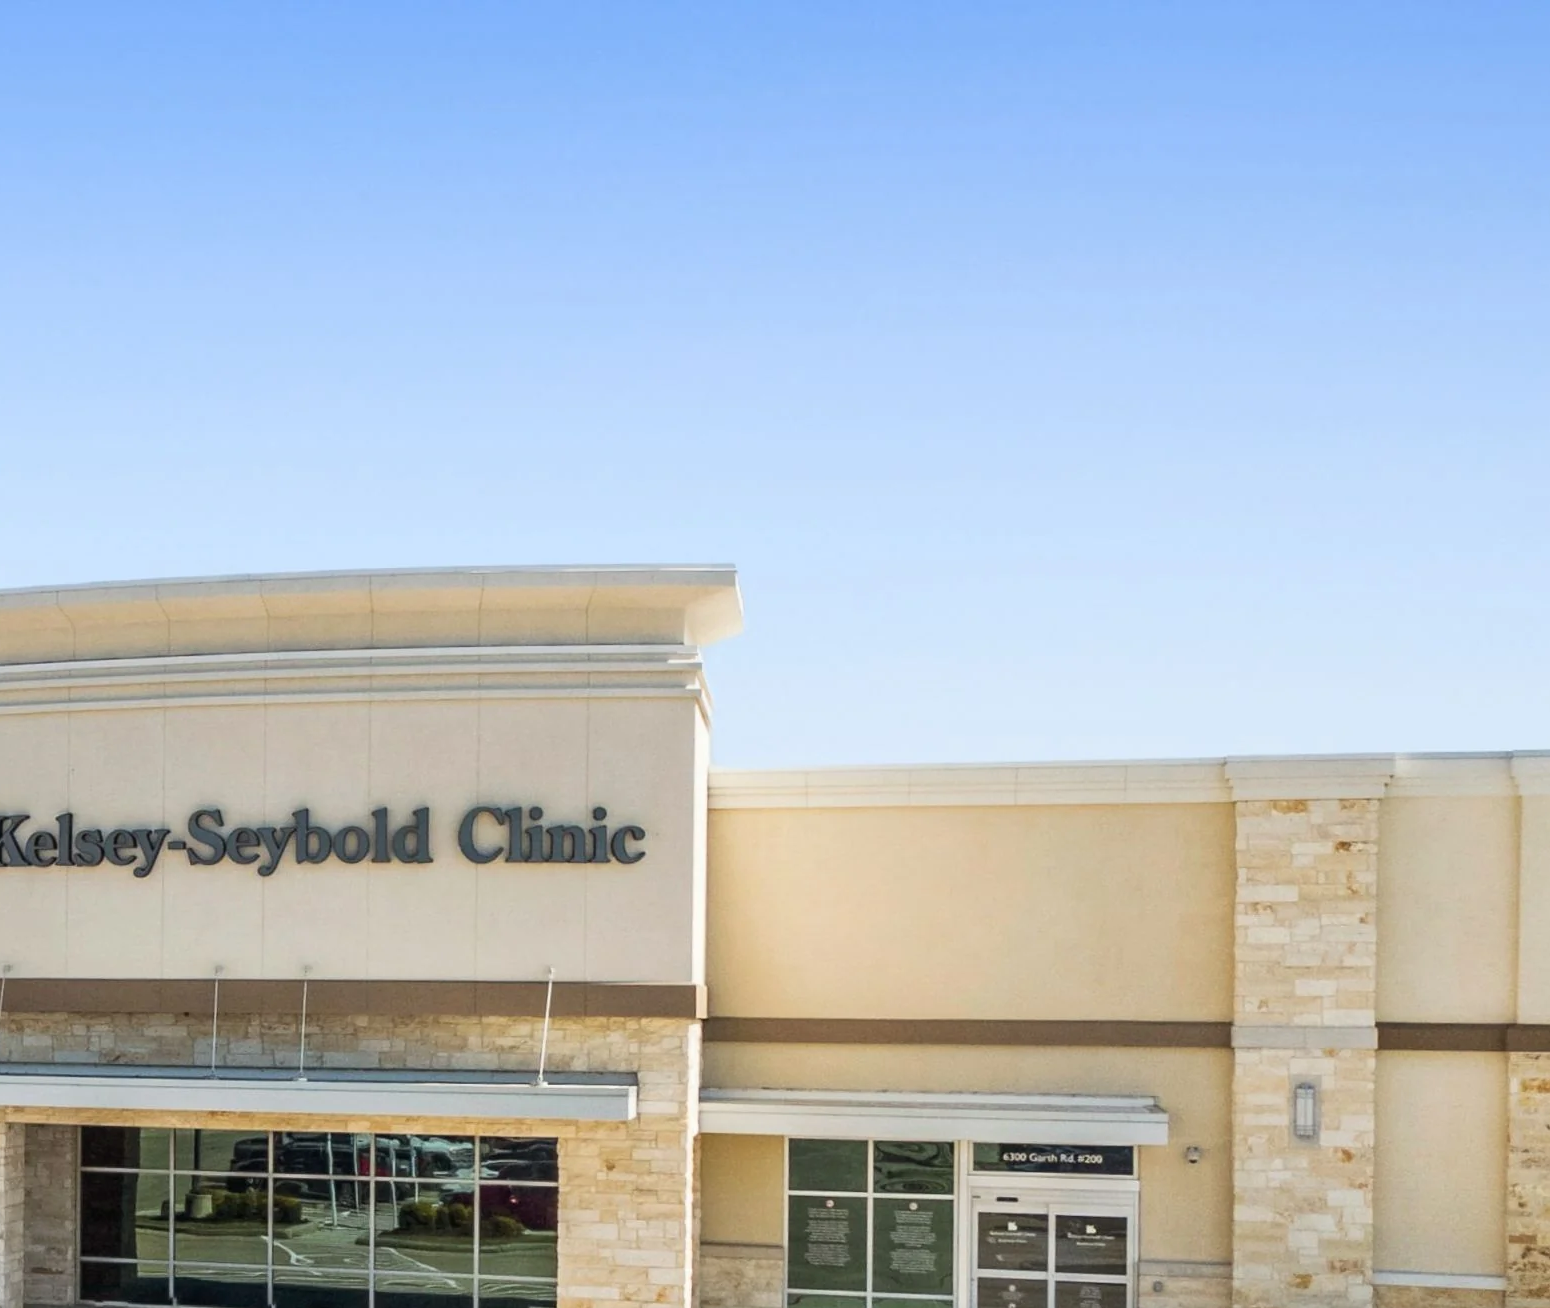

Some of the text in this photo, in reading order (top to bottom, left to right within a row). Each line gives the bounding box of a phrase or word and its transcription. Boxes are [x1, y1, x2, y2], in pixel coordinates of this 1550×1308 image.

[458, 806, 646, 865] Clinic
[1002, 1152, 1027, 1162] 6300
[1029, 1152, 1058, 1163] Garth
